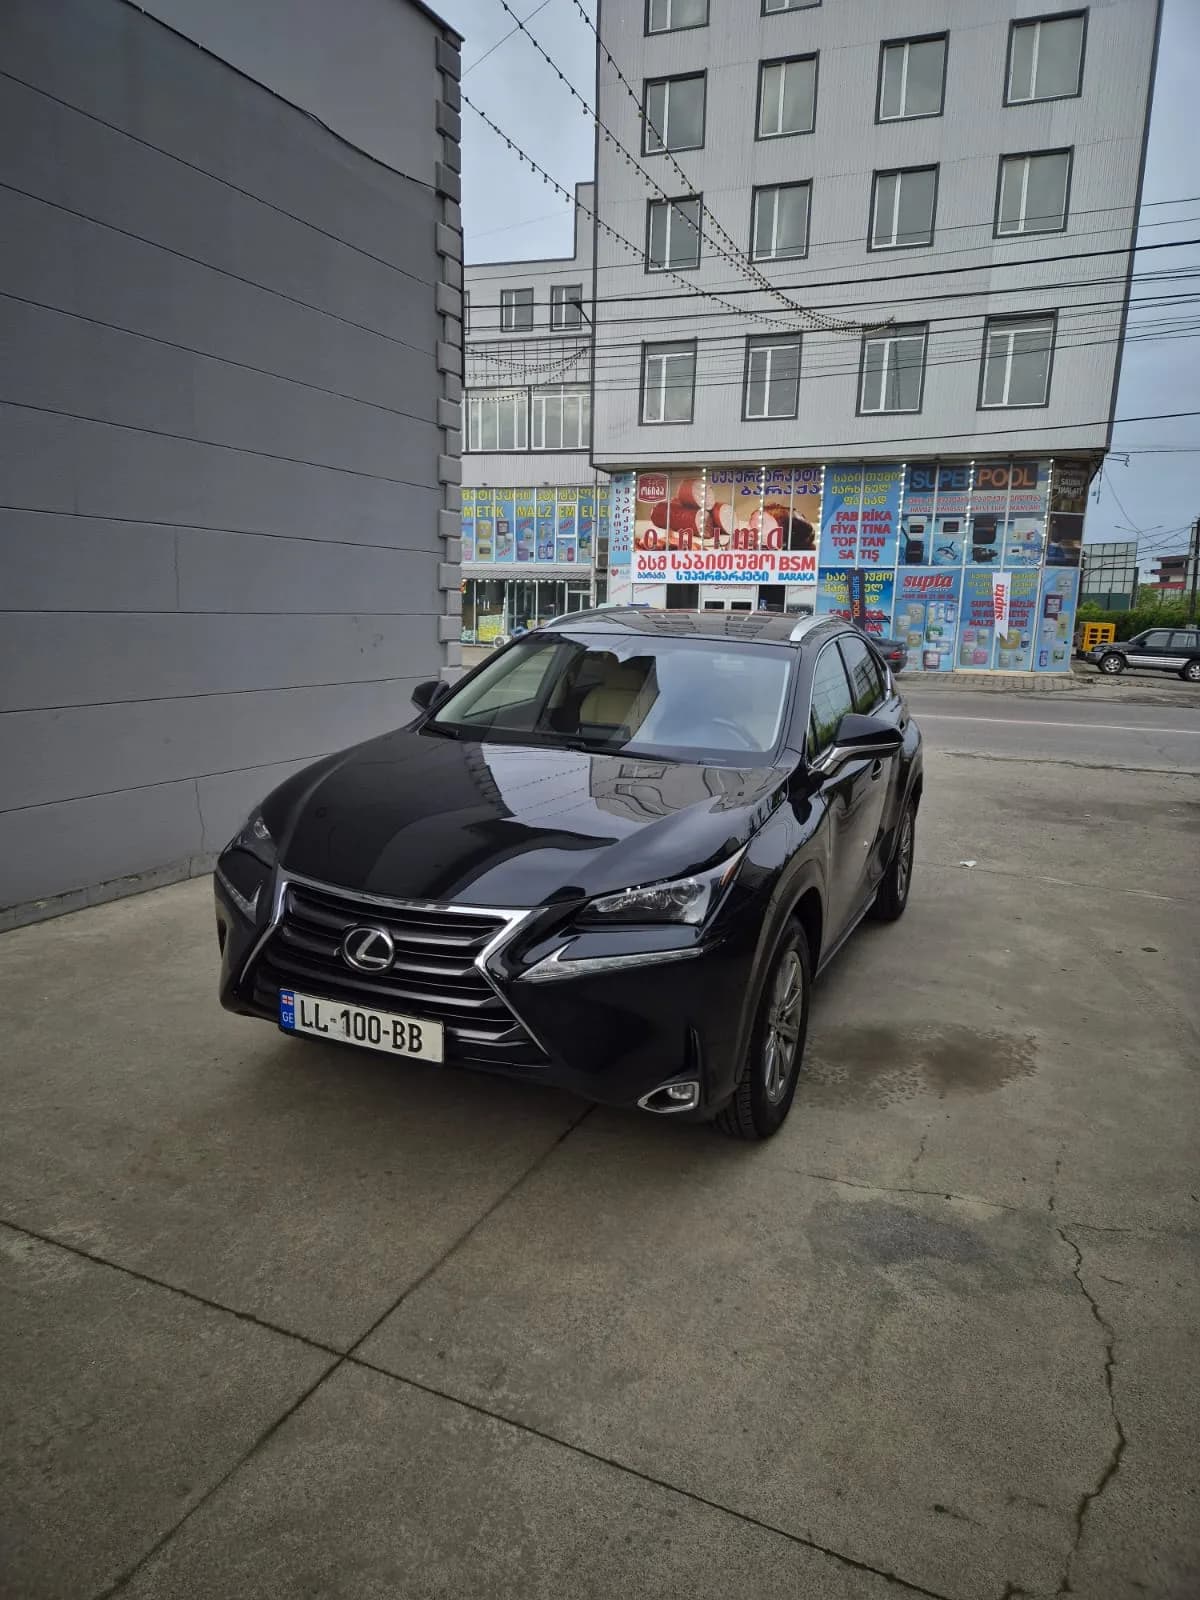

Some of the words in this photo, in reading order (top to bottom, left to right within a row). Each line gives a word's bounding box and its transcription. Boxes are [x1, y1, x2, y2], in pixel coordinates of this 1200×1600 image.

[740, 485, 820, 496] ბარაქა
[836, 509, 892, 521] FABRİKA
[830, 521, 891, 534] FİYATINA
[832, 537, 885, 547] TOPTAN
[637, 555, 667, 571] ბსმ
[671, 553, 775, 571] საბითუმო
[779, 556, 815, 571] BSM
[838, 549, 879, 562] SATIŞ
[676, 571, 769, 582] სუპერმარკეტი
[778, 572, 815, 581] BARAKA
[903, 574, 953, 592] supta
[995, 584, 1006, 620] supta
[282, 1011, 294, 1023] GE
[300, 1000, 423, 1053] LL-100-BB
